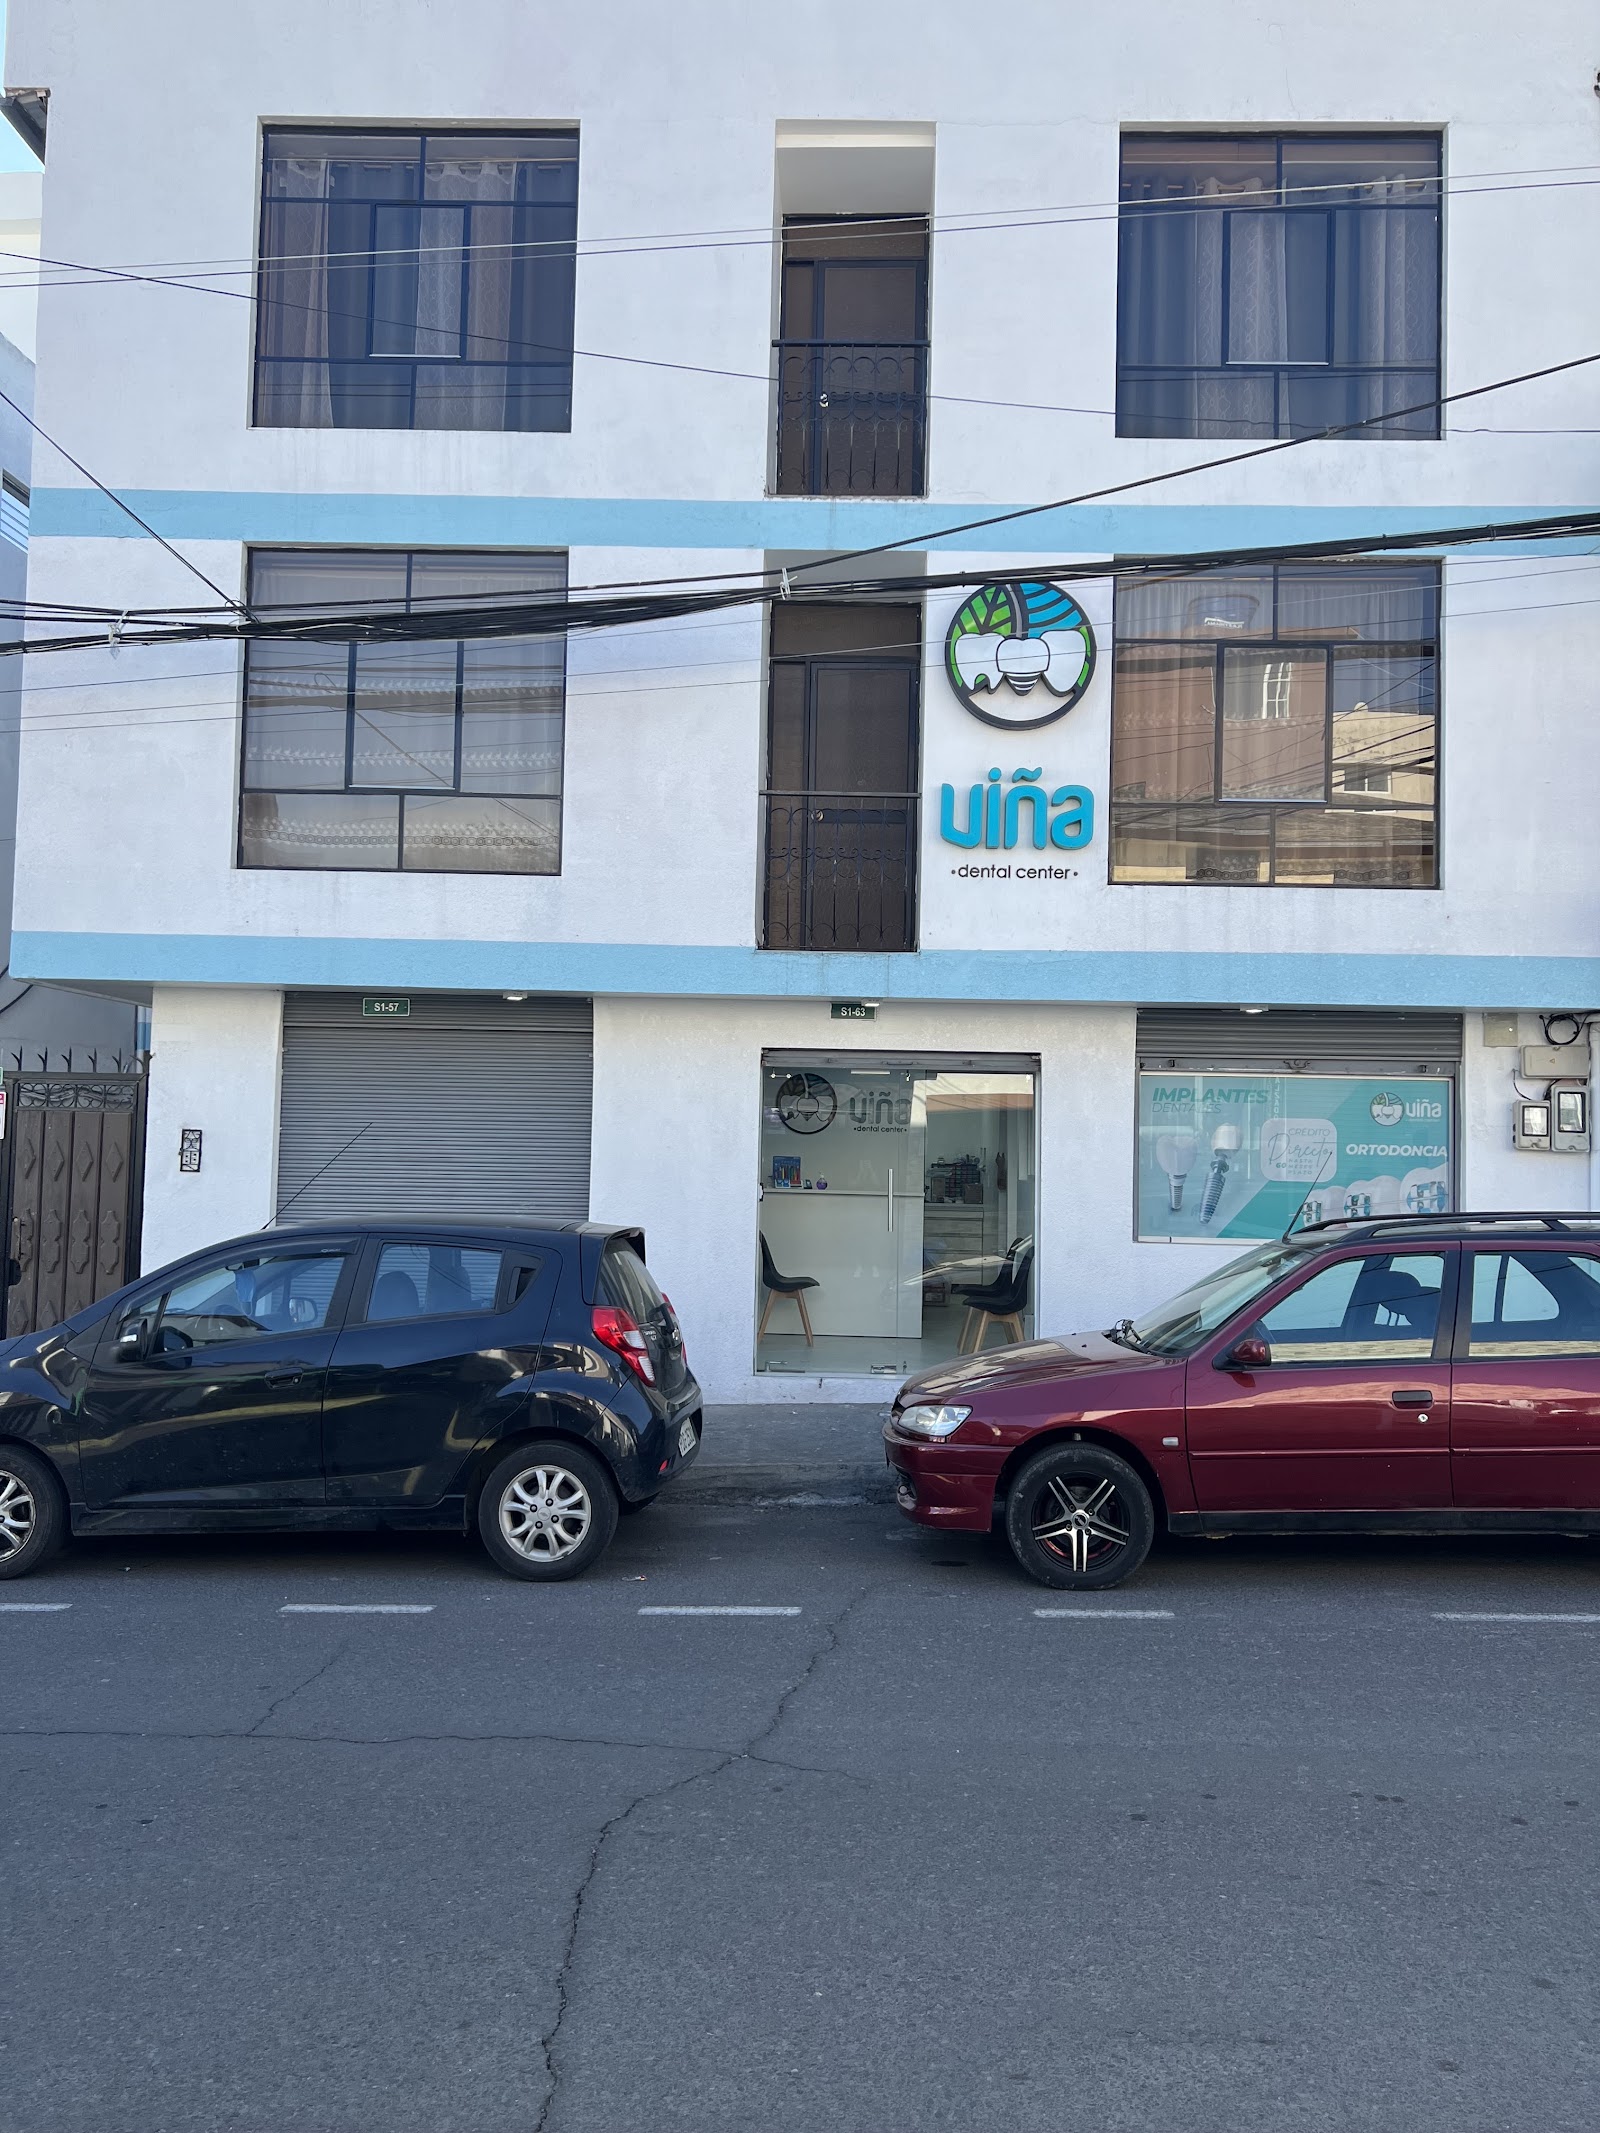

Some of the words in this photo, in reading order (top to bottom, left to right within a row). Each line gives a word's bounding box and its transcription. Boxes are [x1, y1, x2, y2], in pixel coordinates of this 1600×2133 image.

[958, 864, 1011, 879] dental
[1016, 865, 1071, 880] center
[374, 1002, 400, 1012] S1-57
[841, 1006, 866, 1017] S1-63
[1152, 1087, 1270, 1104] IMPLANTES
[1345, 1143, 1448, 1157] ORTODONCIA
